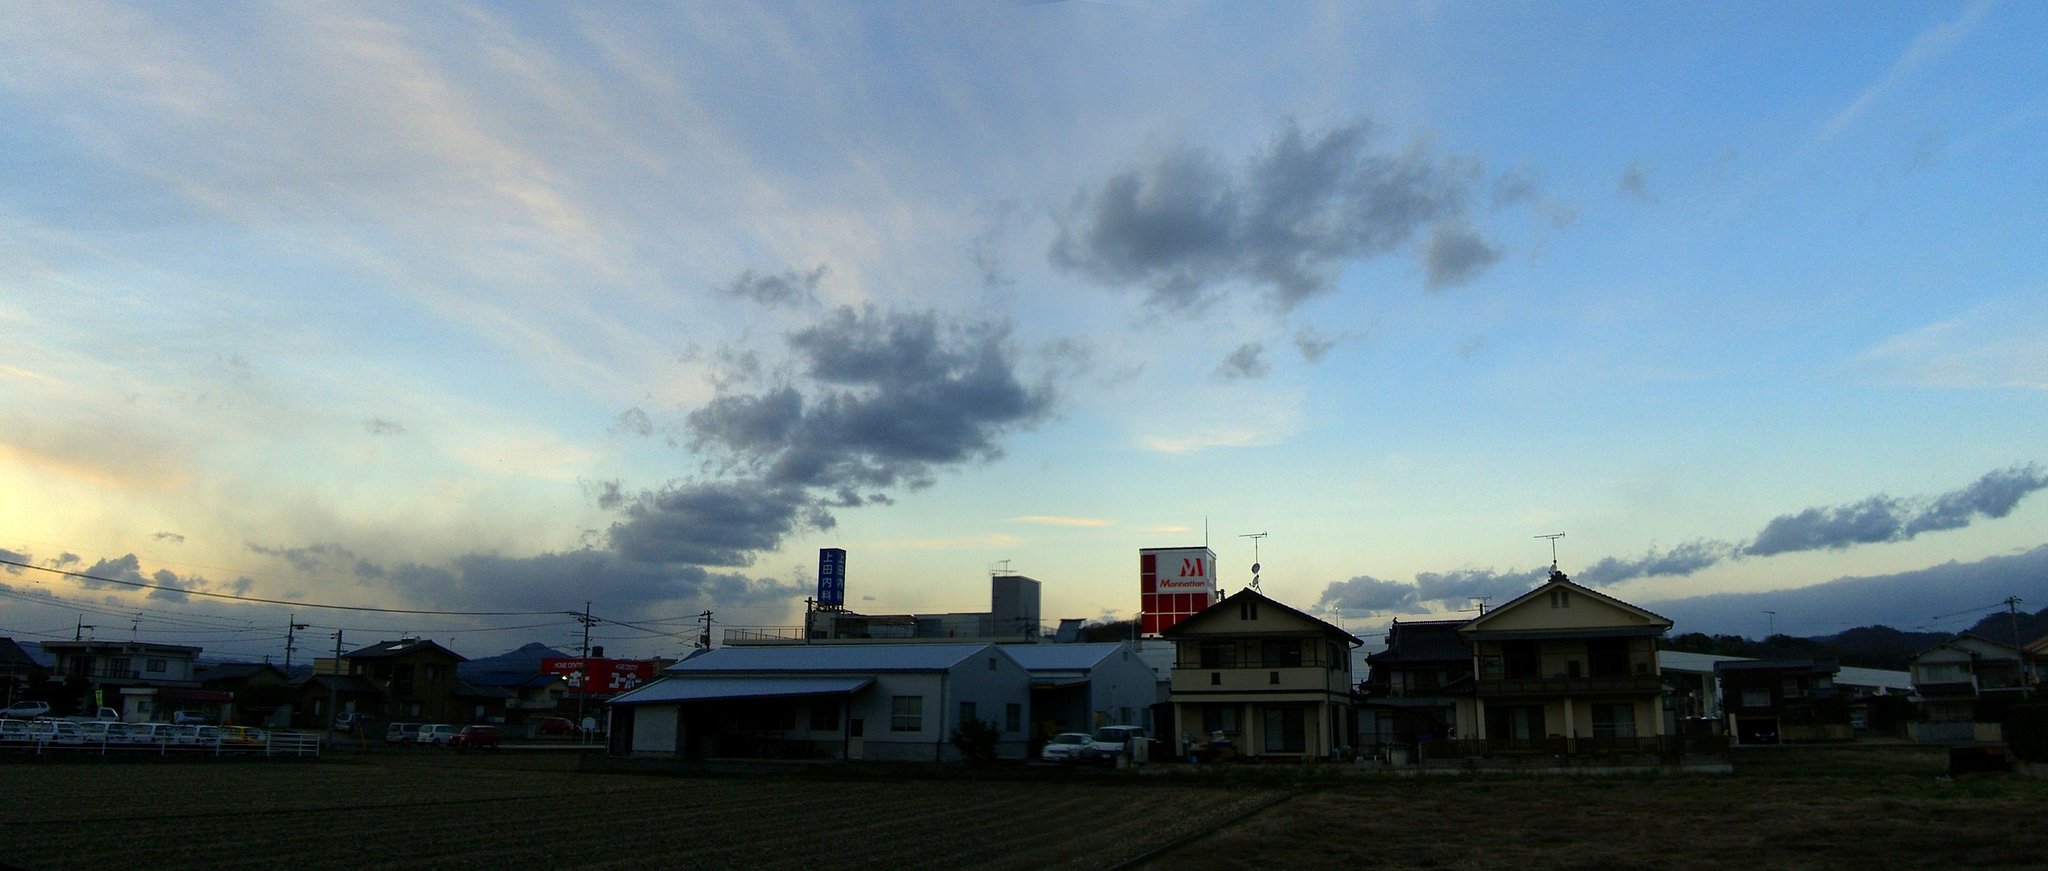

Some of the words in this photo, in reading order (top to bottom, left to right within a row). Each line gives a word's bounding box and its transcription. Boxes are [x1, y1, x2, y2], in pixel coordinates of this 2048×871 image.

[821, 552, 833, 601] 上田内科
[1180, 558, 1204, 577] M
[1160, 579, 1205, 588] Manhattan
